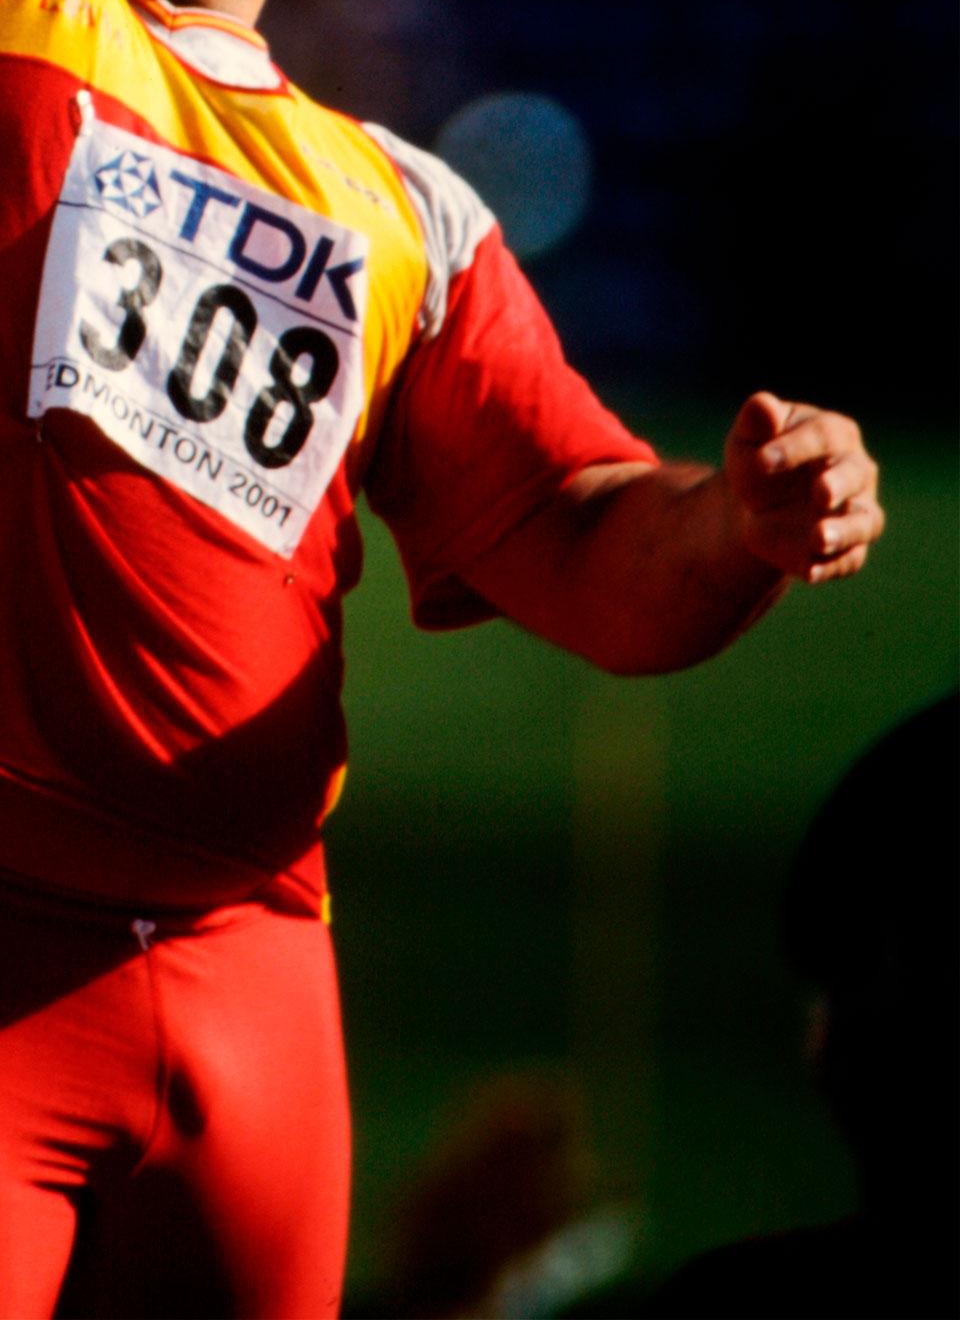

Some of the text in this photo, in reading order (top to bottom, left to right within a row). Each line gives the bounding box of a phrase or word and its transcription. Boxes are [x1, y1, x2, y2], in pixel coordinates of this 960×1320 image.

[170, 169, 365, 321] TDK
[79, 237, 339, 470] 308
[228, 473, 292, 528] 2001
